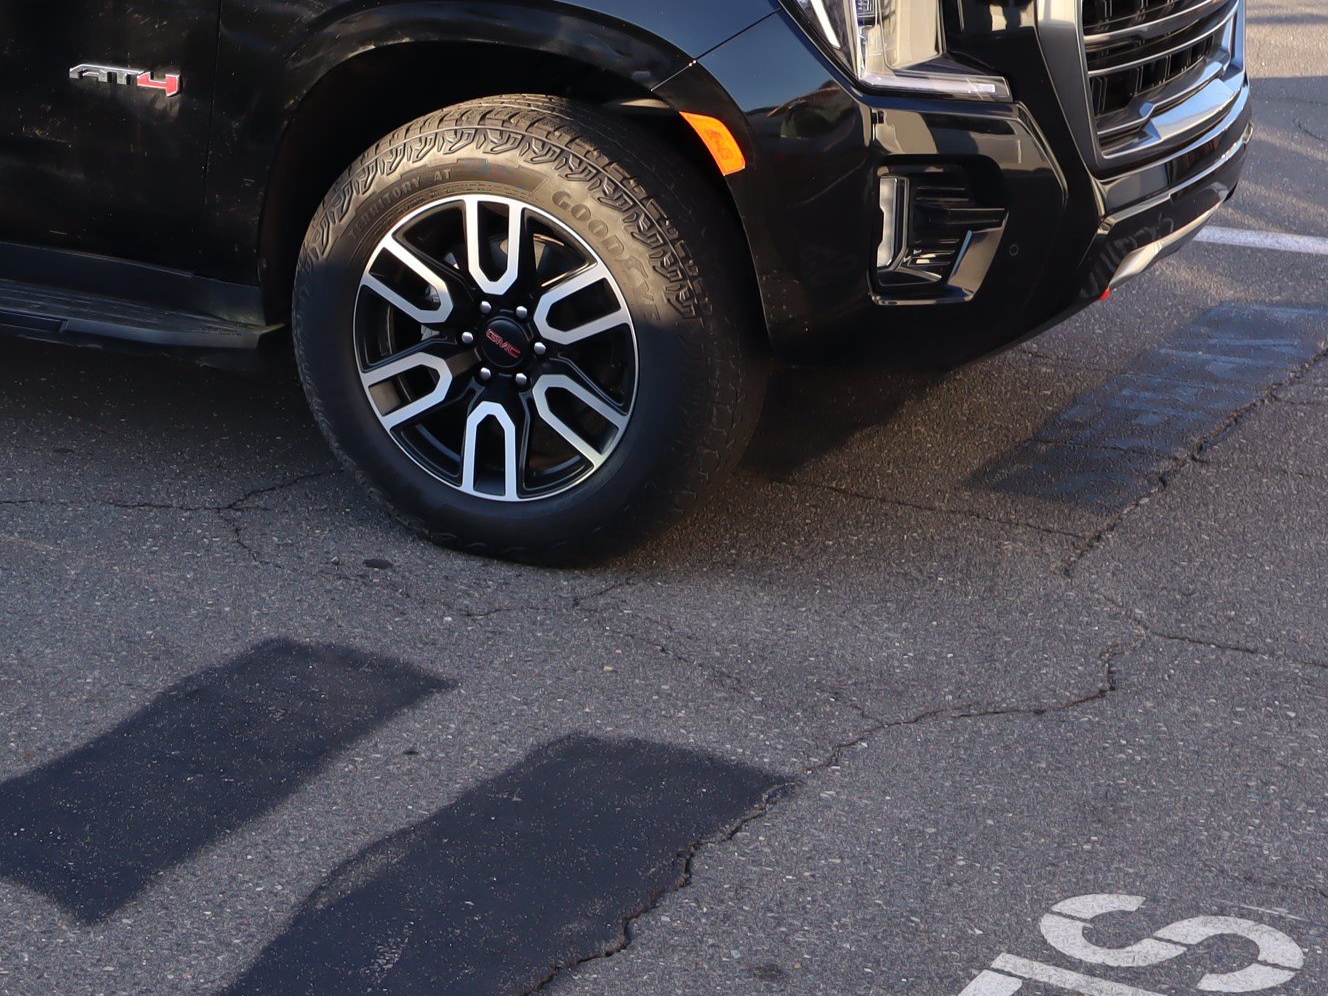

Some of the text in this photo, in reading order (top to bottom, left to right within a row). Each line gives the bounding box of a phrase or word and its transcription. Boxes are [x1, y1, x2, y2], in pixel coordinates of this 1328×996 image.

[69, 64, 180, 96] AT4
[348, 176, 422, 238] TERRITORY
[433, 169, 452, 182] AT
[486, 329, 521, 358] GMC
